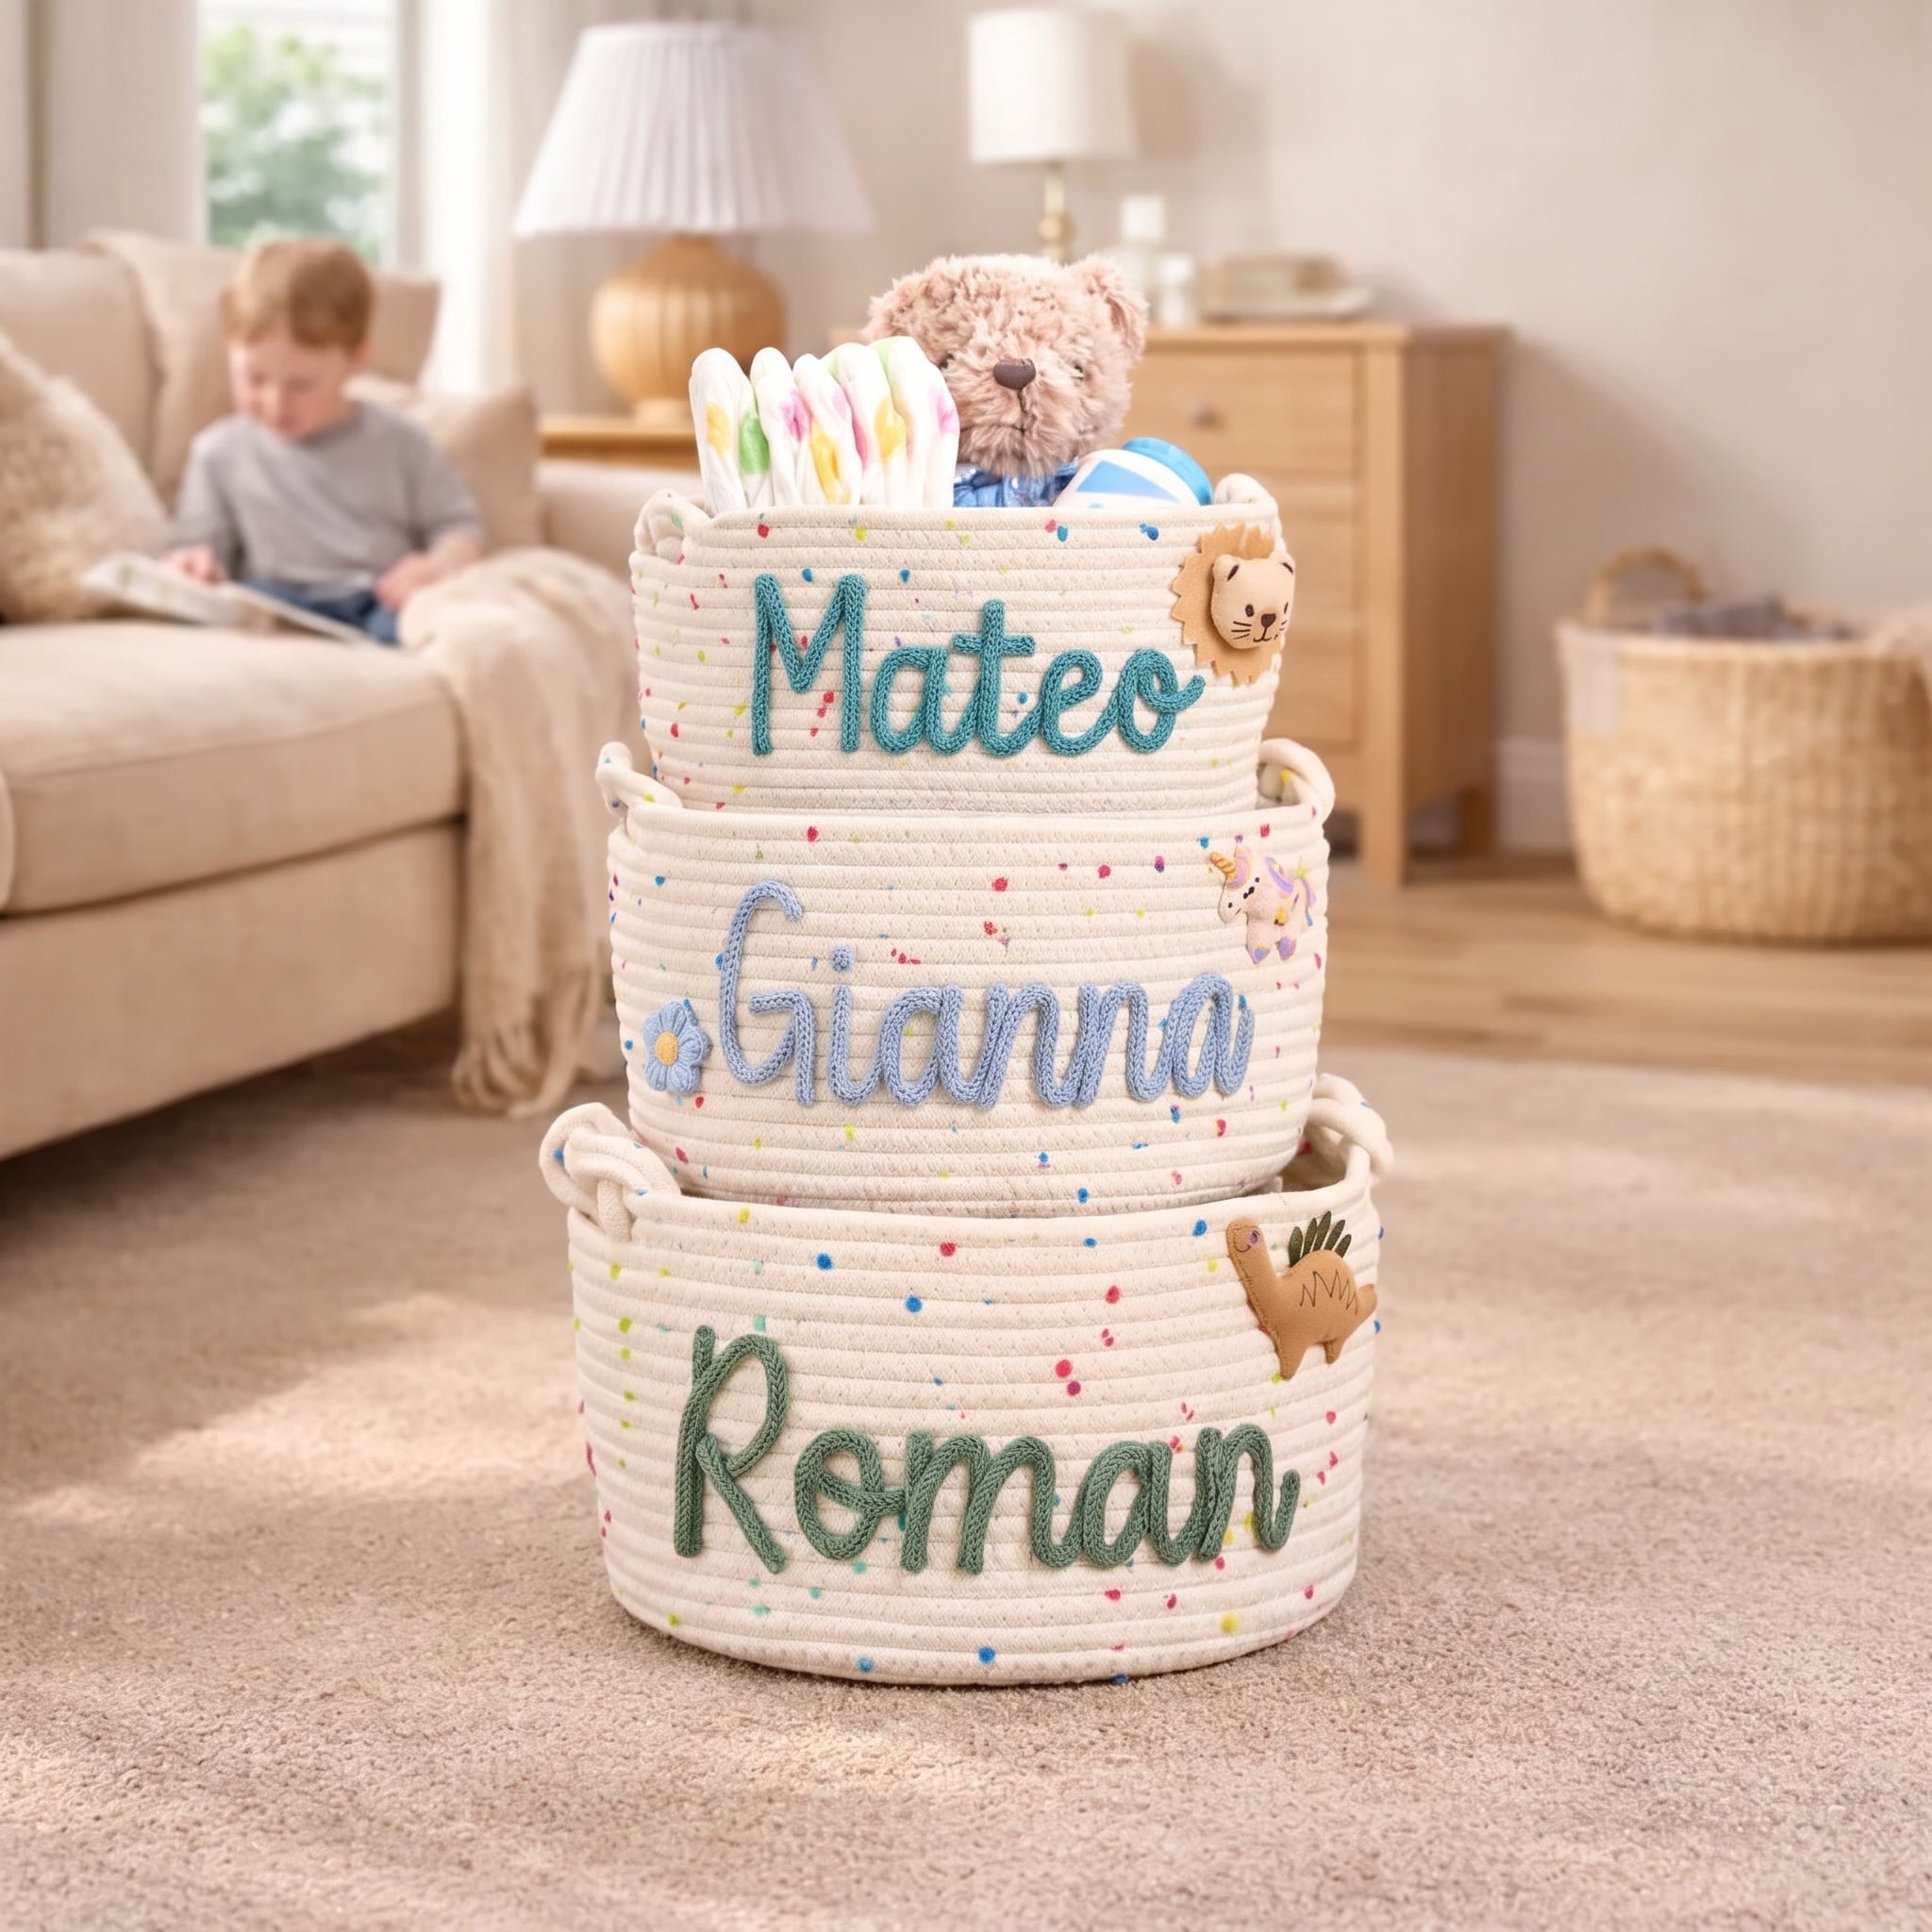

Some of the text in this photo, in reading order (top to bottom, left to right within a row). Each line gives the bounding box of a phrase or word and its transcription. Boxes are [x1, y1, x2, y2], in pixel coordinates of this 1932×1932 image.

[751, 574, 1205, 758] Mateo
[719, 879, 1255, 1109] Gianna
[674, 1324, 1300, 1574] Roman
